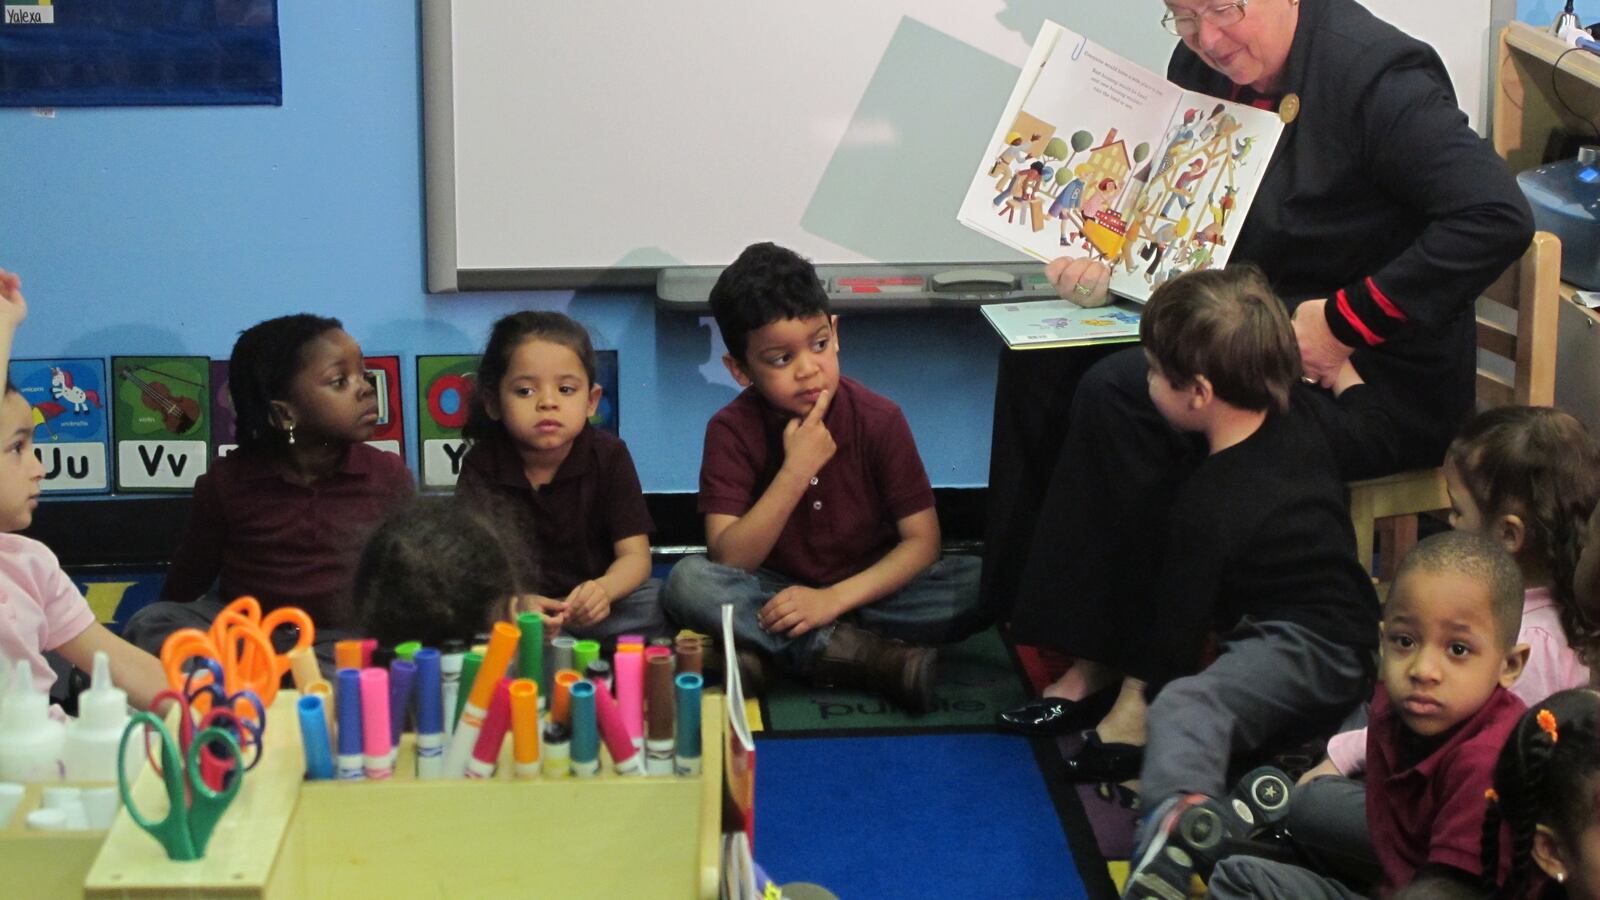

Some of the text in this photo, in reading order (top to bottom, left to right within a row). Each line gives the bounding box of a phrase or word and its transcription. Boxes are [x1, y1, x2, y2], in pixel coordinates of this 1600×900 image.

[7, 9, 42, 24] Yalexa
[138, 444, 187, 477] Vv
[442, 443, 467, 475] Y
[820, 698, 986, 719] pule
